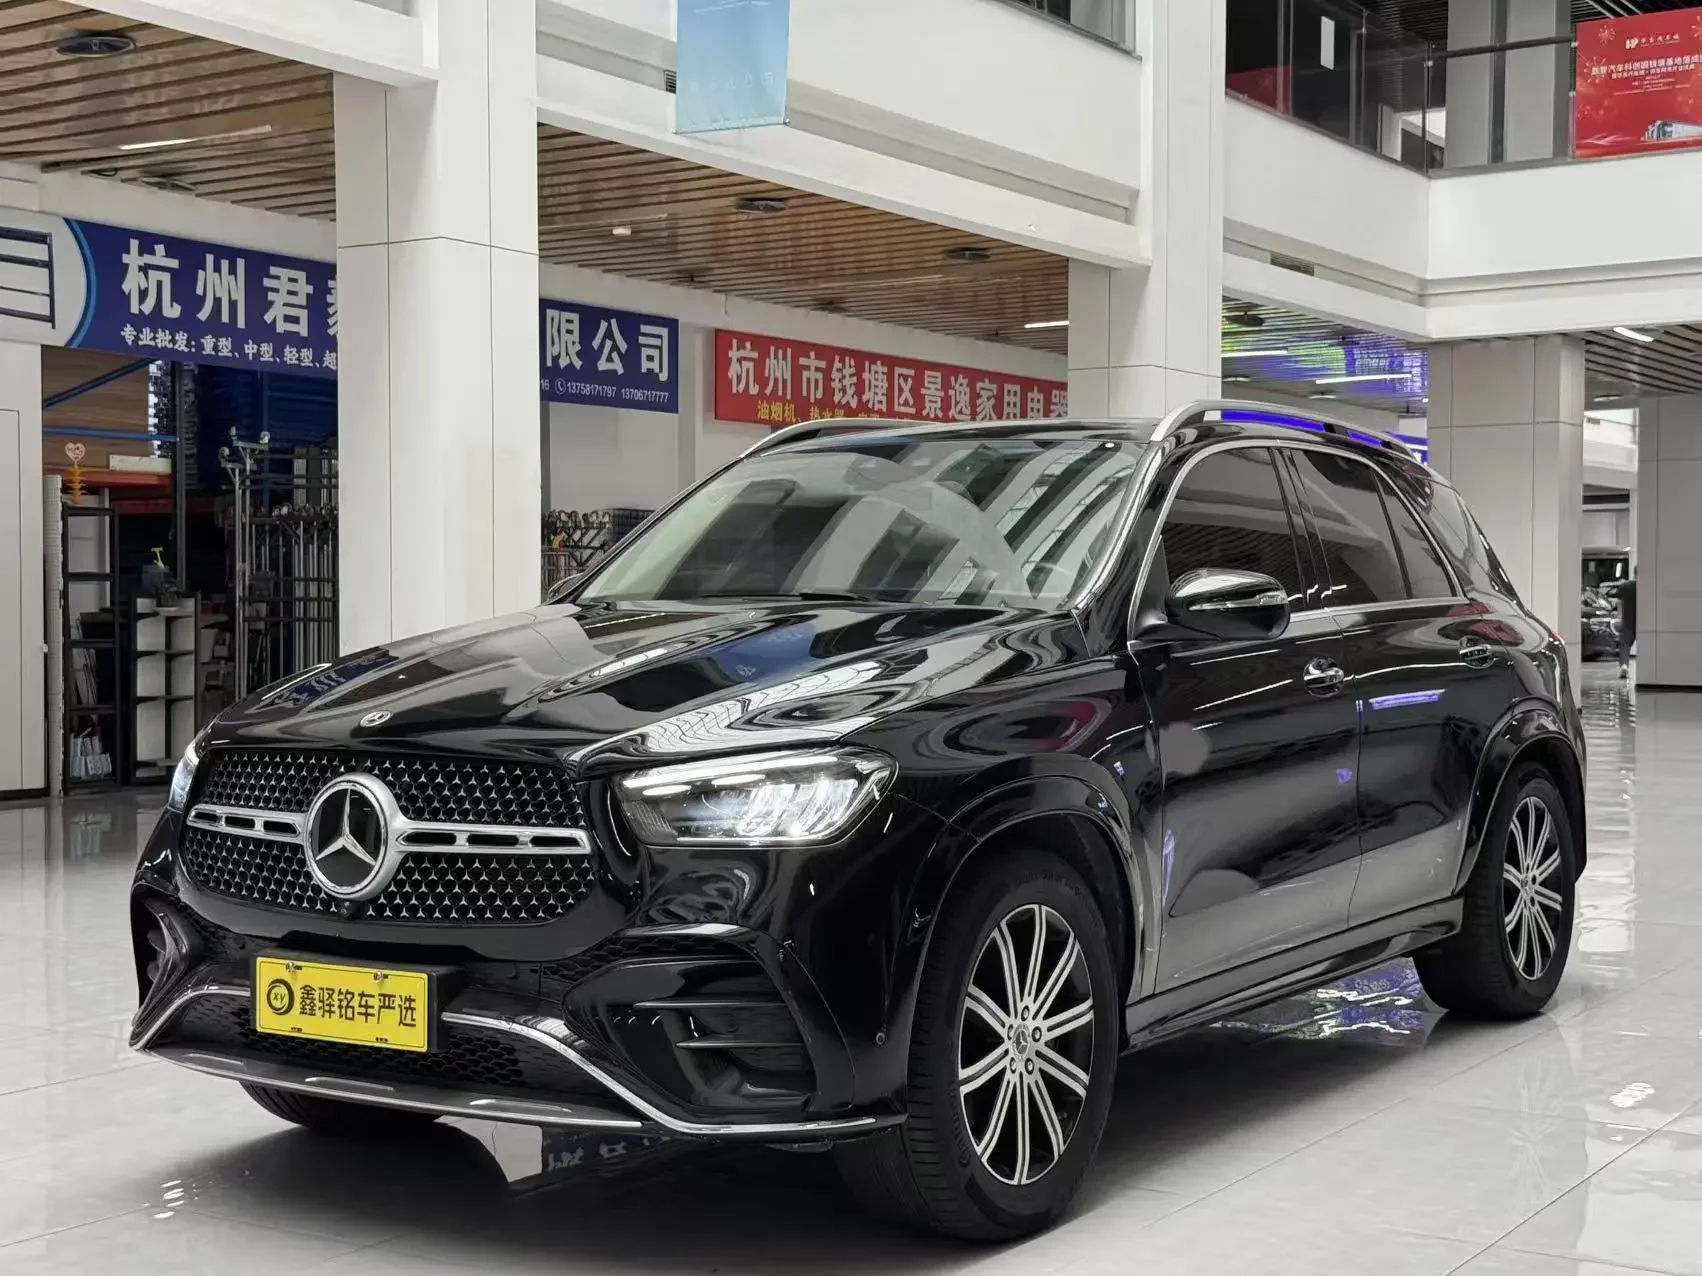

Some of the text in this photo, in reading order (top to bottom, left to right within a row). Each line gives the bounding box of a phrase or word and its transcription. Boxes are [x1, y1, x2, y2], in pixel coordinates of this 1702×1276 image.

[121, 238, 669, 382] 杭州君 限公司
[567, 381, 617, 398] 13758171797
[299, 984, 417, 1028] 鑫驿铭车严选
